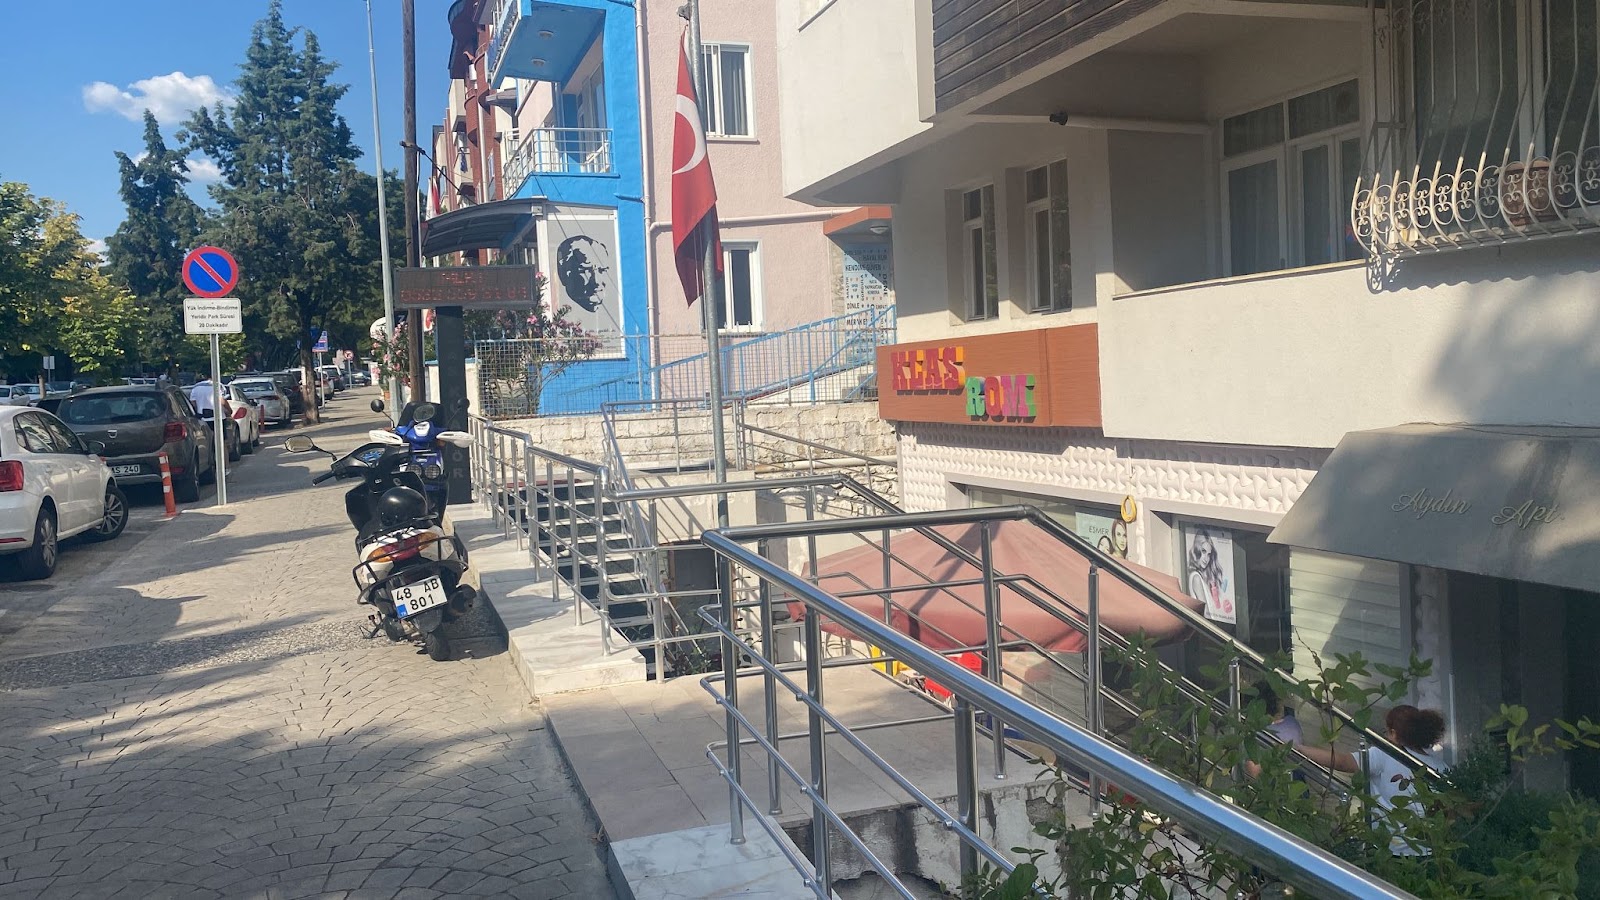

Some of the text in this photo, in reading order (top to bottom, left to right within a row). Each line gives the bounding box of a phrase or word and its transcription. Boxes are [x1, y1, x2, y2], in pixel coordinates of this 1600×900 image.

[123, 465, 139, 473] 240
[1089, 526, 1109, 535] ESMER
[396, 579, 439, 601] 48 AB
[410, 594, 434, 610] 801
